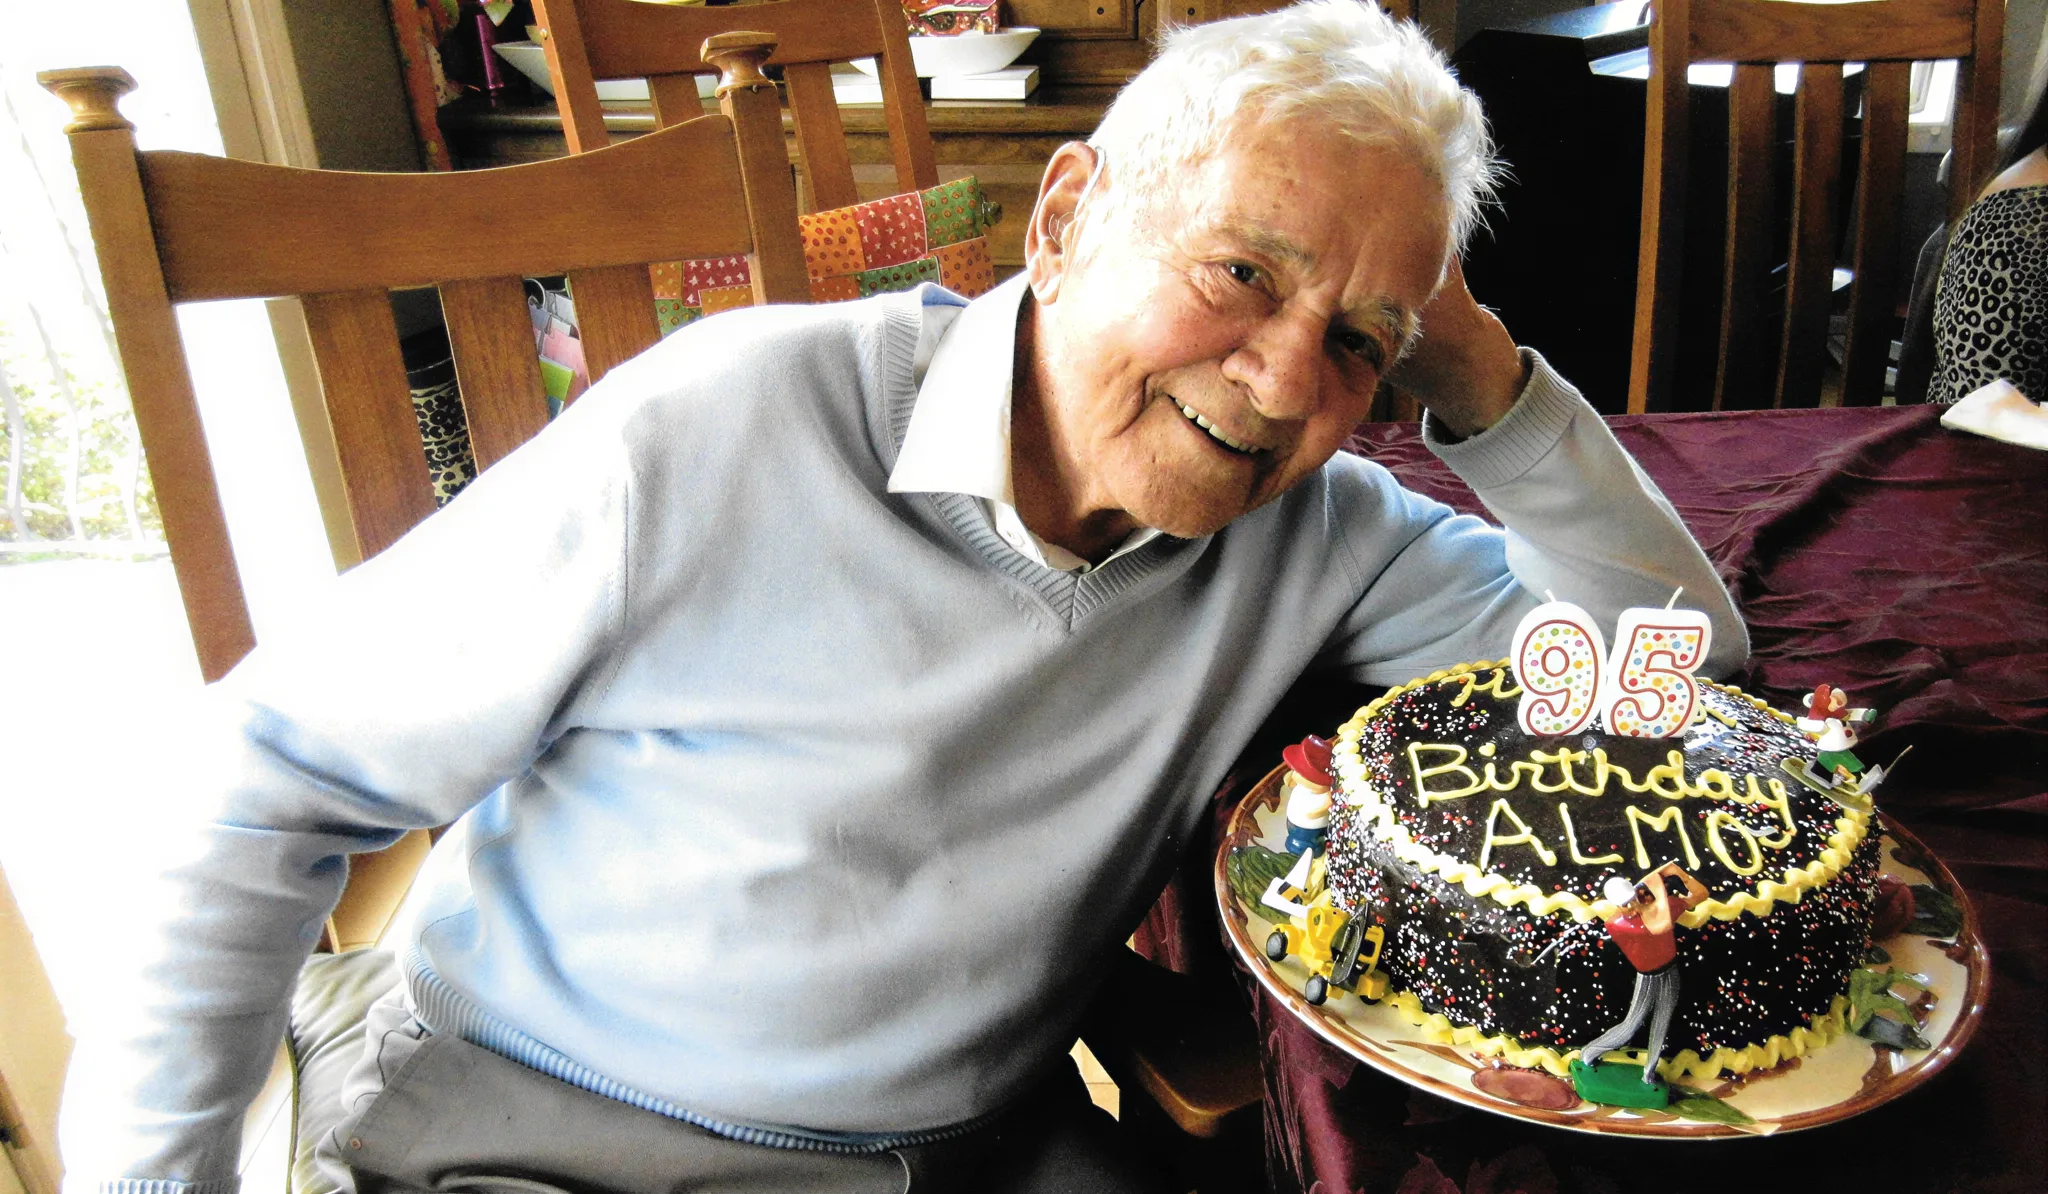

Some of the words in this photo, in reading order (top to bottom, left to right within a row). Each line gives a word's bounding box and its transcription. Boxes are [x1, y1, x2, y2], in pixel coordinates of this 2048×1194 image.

[1515, 610, 1707, 738] 95
[1408, 742, 1797, 849] Birthday
[1480, 798, 1763, 876] ALMO
